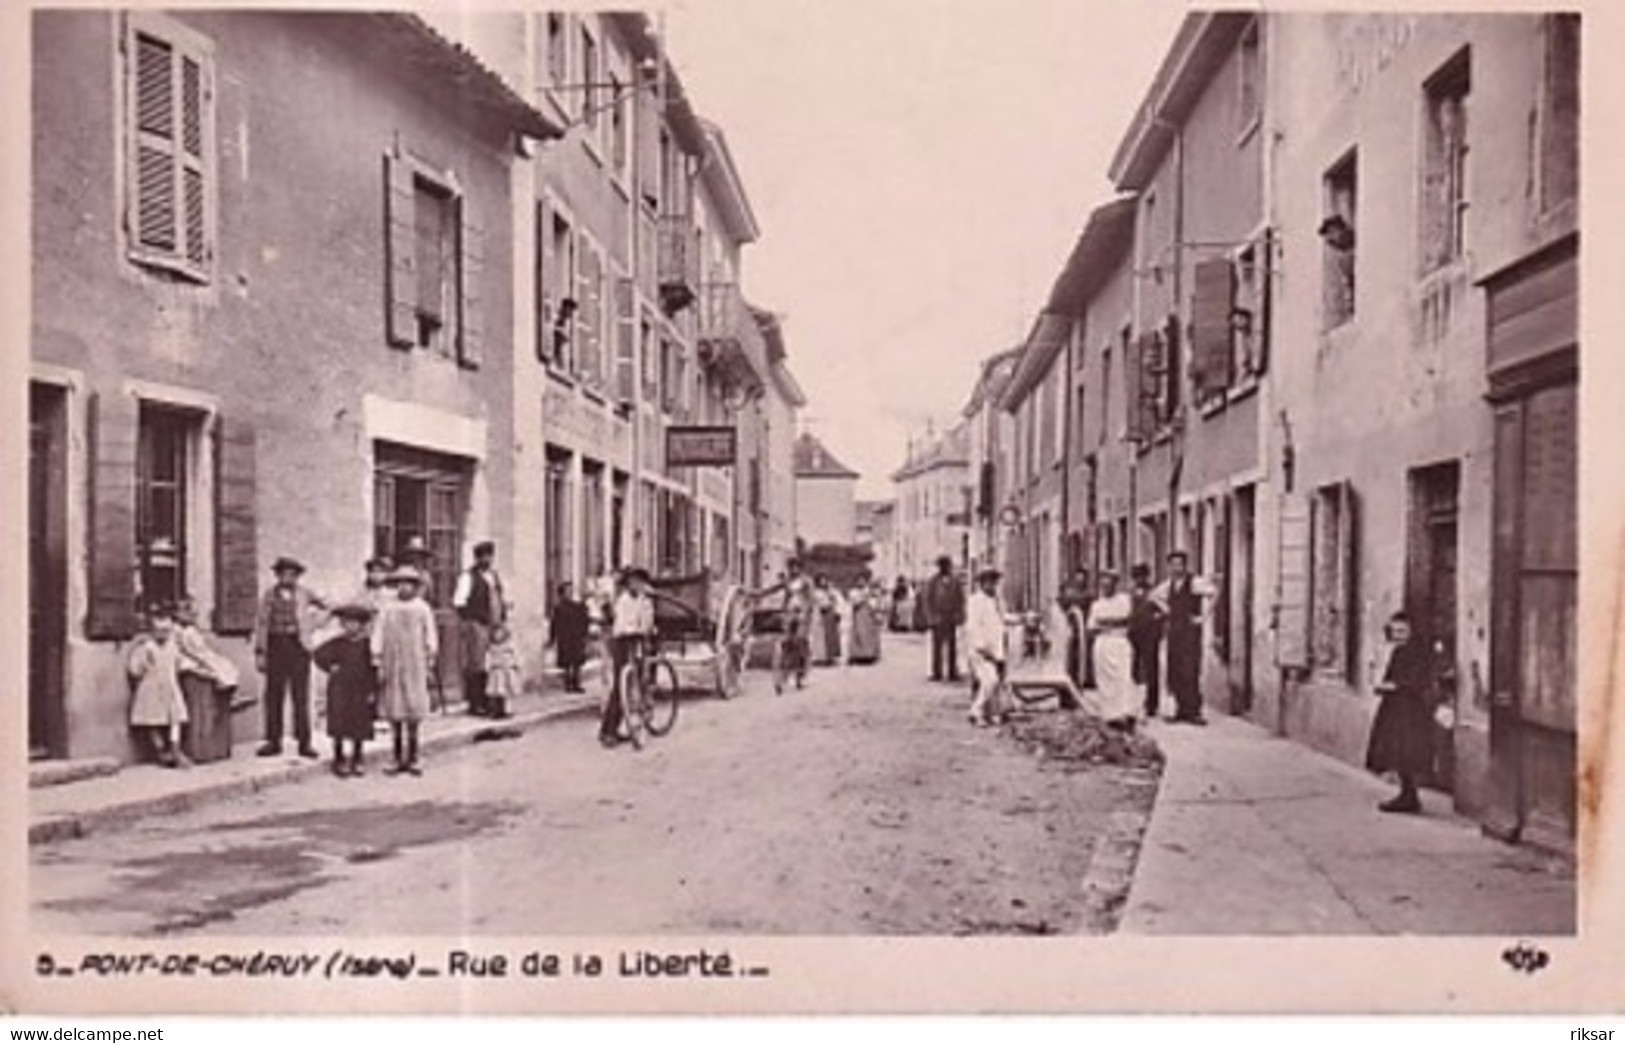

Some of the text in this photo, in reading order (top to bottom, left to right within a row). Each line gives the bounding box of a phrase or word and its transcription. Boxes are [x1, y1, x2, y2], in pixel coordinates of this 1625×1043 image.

[449, 951, 507, 976] Rue
[521, 953, 559, 976] de
[573, 955, 602, 976] la
